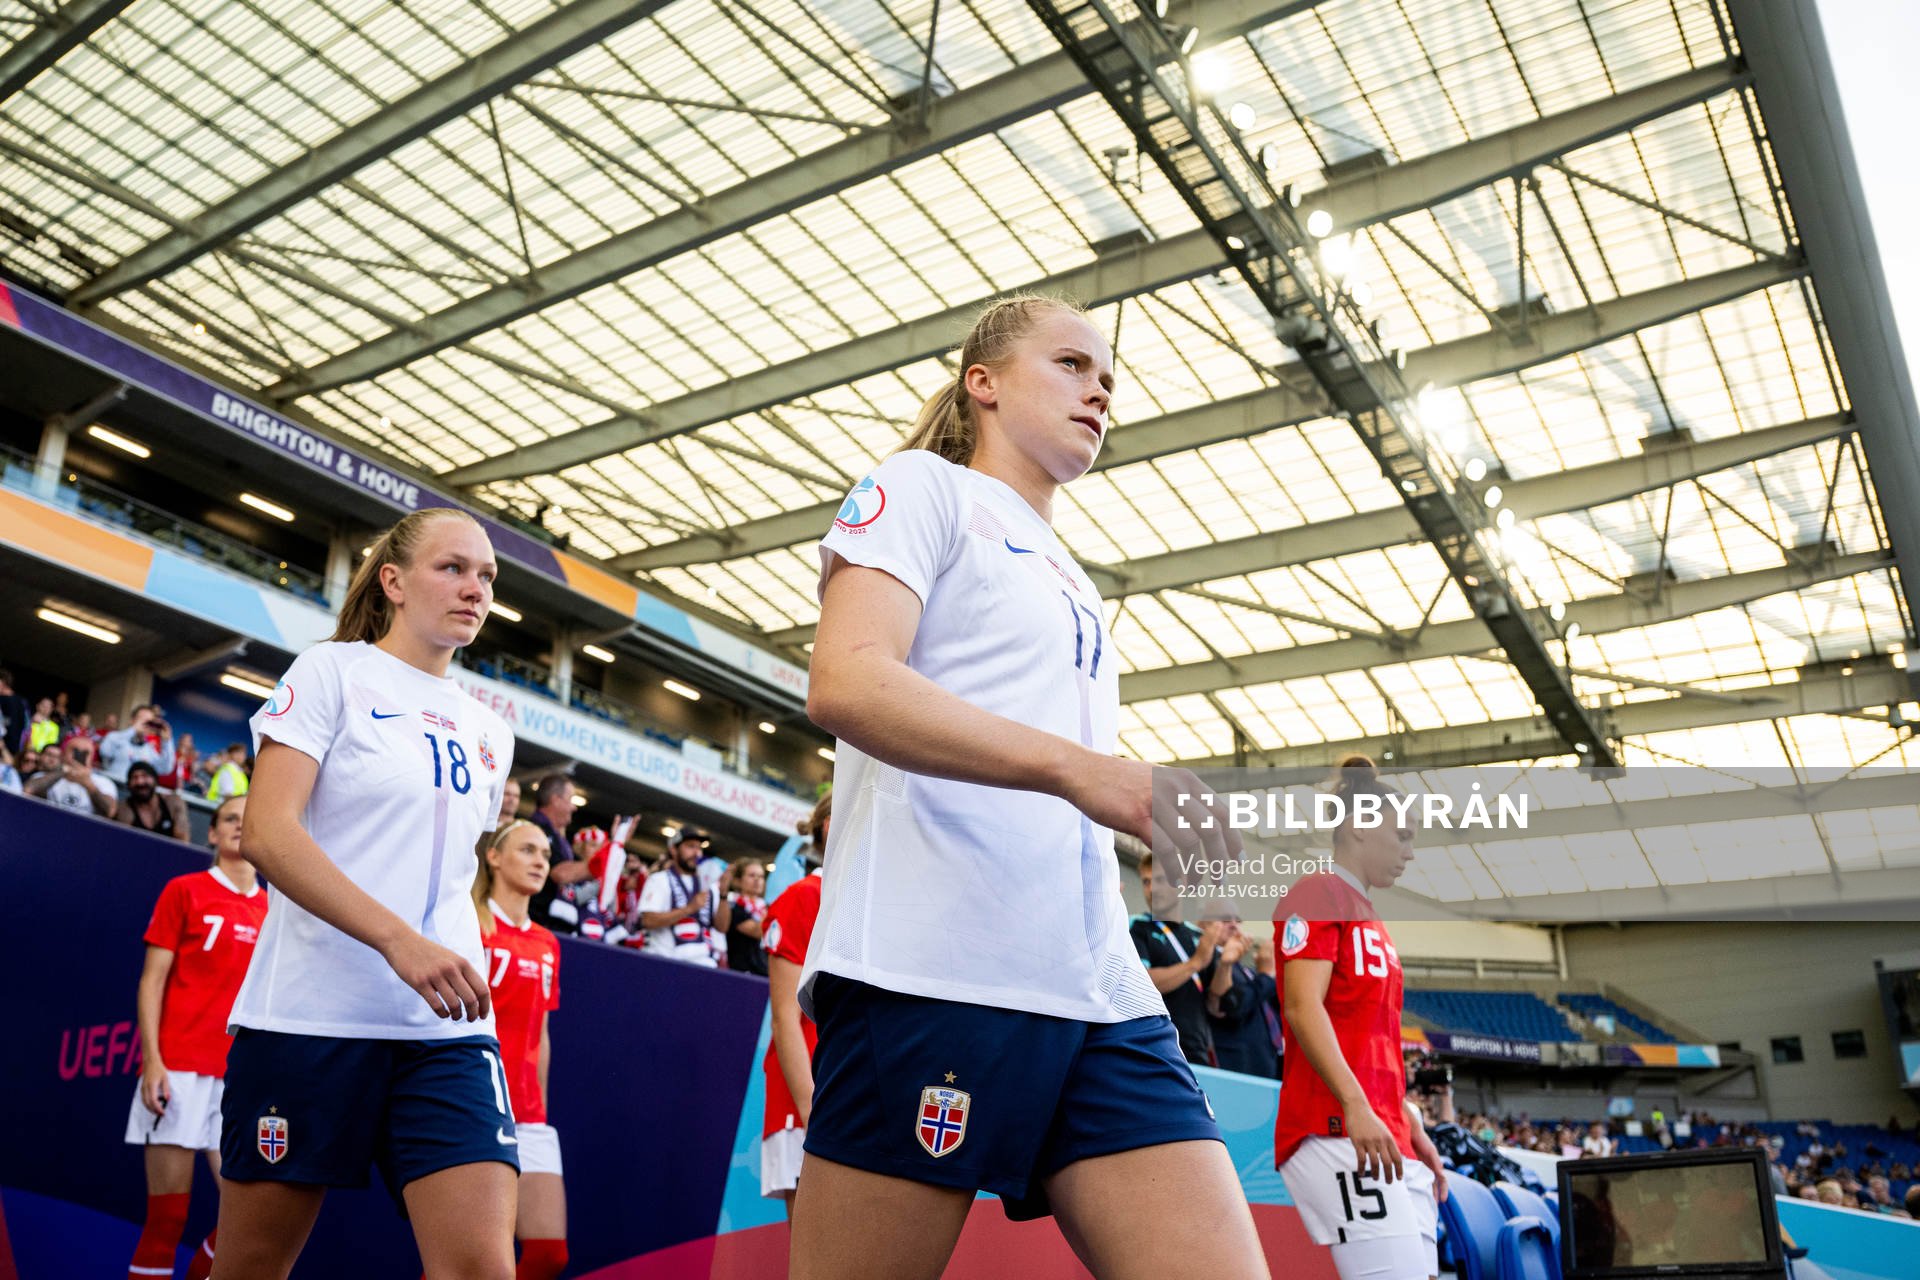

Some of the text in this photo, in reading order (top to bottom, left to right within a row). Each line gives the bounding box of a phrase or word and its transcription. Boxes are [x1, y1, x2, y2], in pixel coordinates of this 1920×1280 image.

[211, 393, 420, 508] BRIGHTON & HOVE
[849, 527, 867, 535] 2022
[1061, 589, 1102, 680] 17
[424, 732, 471, 795] 18
[523, 704, 621, 761] WOMEN'S
[626, 746, 680, 783] EURO
[683, 767, 766, 816] ENGLAND
[202, 914, 225, 952] 7
[1352, 926, 1388, 978] 15
[1450, 1035, 1503, 1056] BRIGHTON
[1514, 1043, 1540, 1060] HOVE
[481, 1050, 516, 1123] 1
[1335, 1170, 1388, 1221] 15
